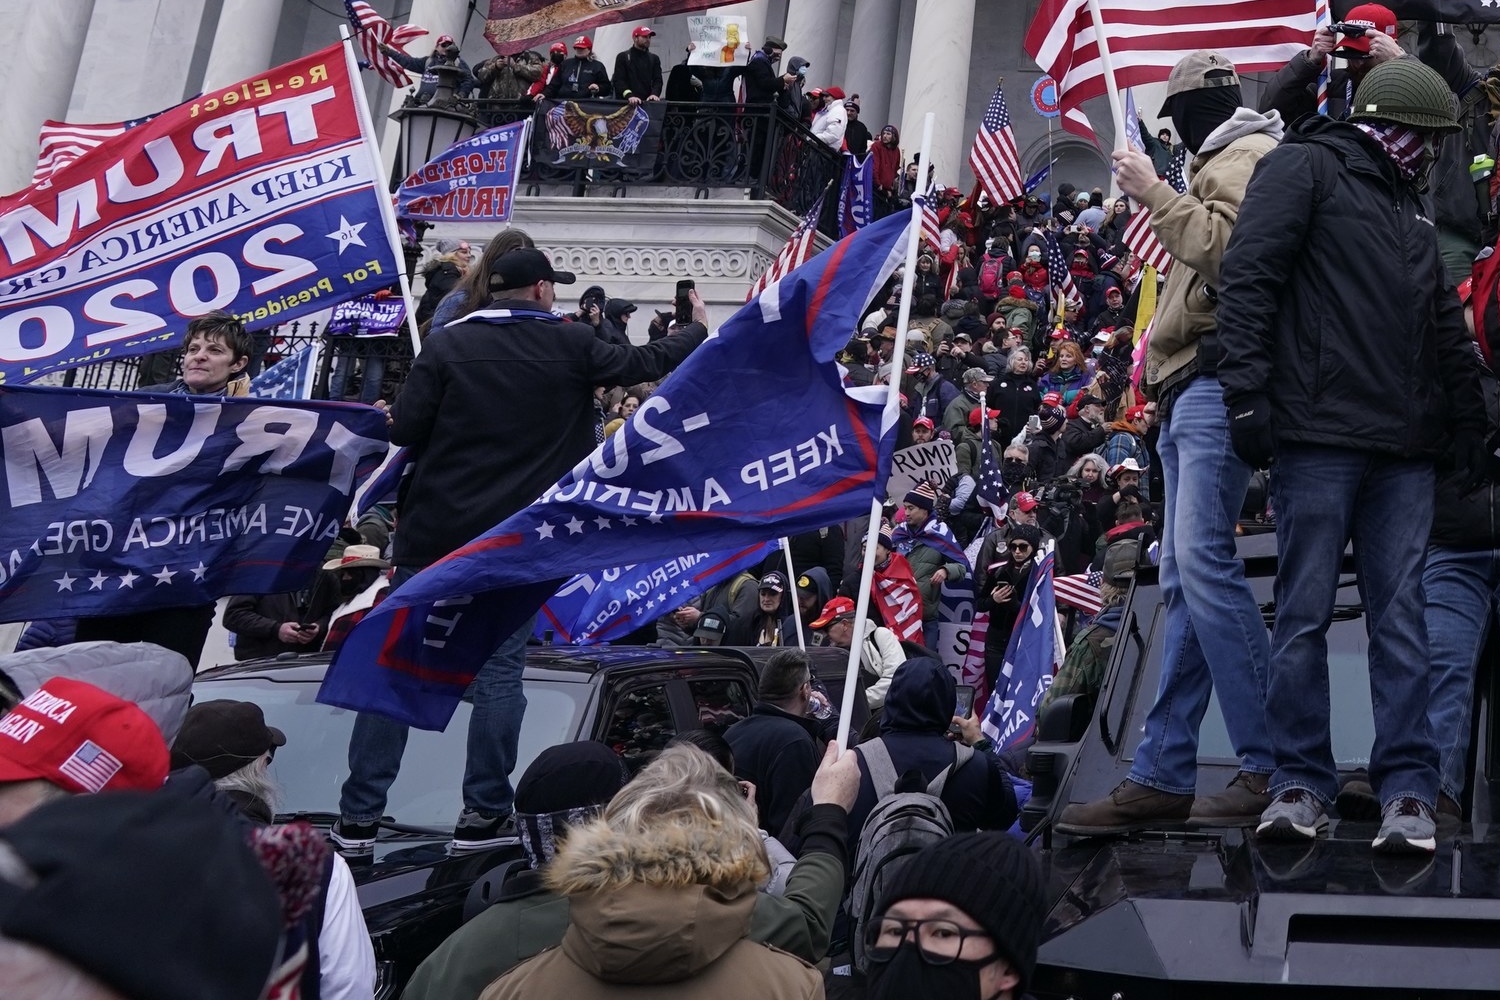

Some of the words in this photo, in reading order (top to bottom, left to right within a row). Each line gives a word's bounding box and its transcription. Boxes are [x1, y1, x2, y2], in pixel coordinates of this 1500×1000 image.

[333, 309, 399, 322] SWAMP
[378, 304, 402, 313] THE
[891, 444, 953, 474] RUMP
[908, 468, 952, 486] WON
[20, 688, 77, 724] MERICA
